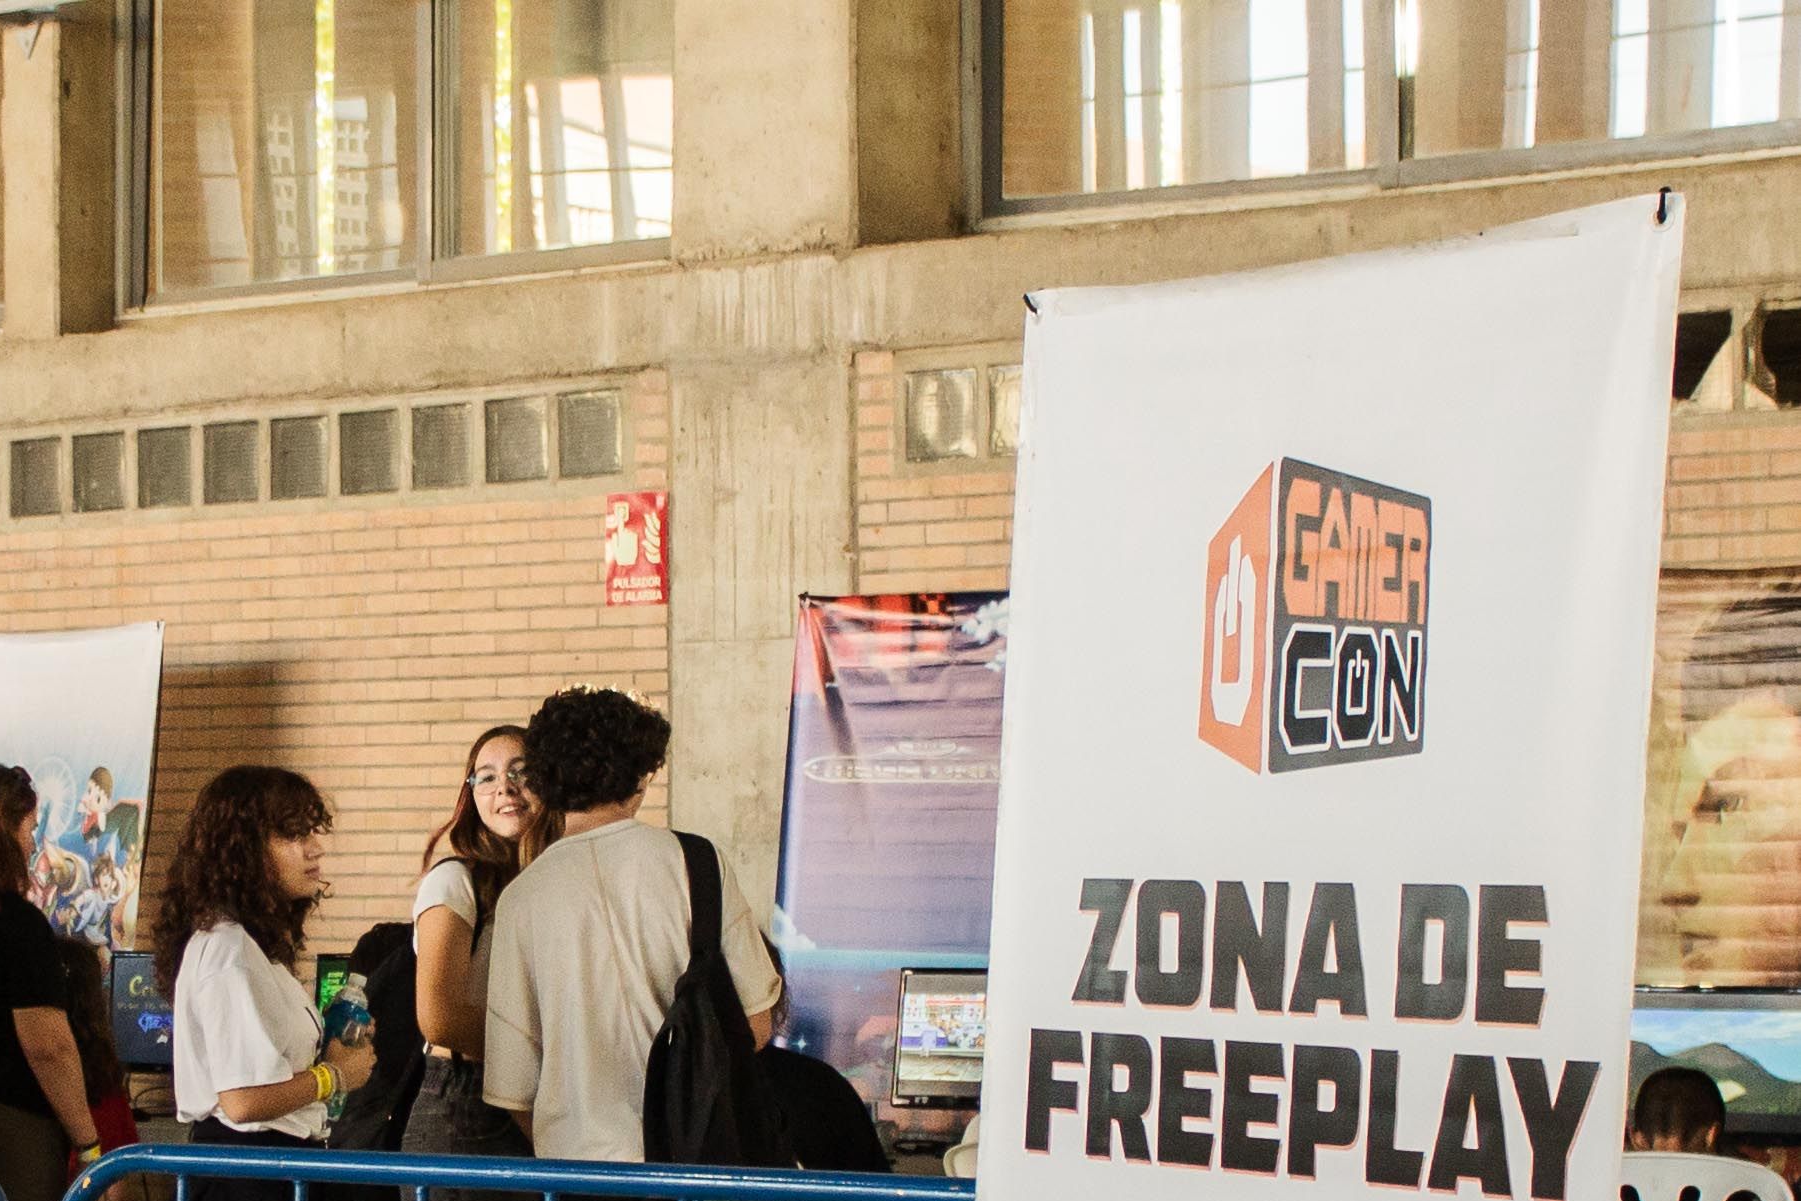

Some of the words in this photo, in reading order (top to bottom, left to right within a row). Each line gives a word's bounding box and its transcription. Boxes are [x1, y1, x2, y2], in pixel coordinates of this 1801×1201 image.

[610, 590, 624, 602] DE
[612, 576, 662, 589] PULSADOR
[1282, 477, 1427, 625] GAMER
[1279, 622, 1424, 754] CON
[1071, 877, 1369, 1018] ZONA
[1395, 883, 1550, 1028] DE
